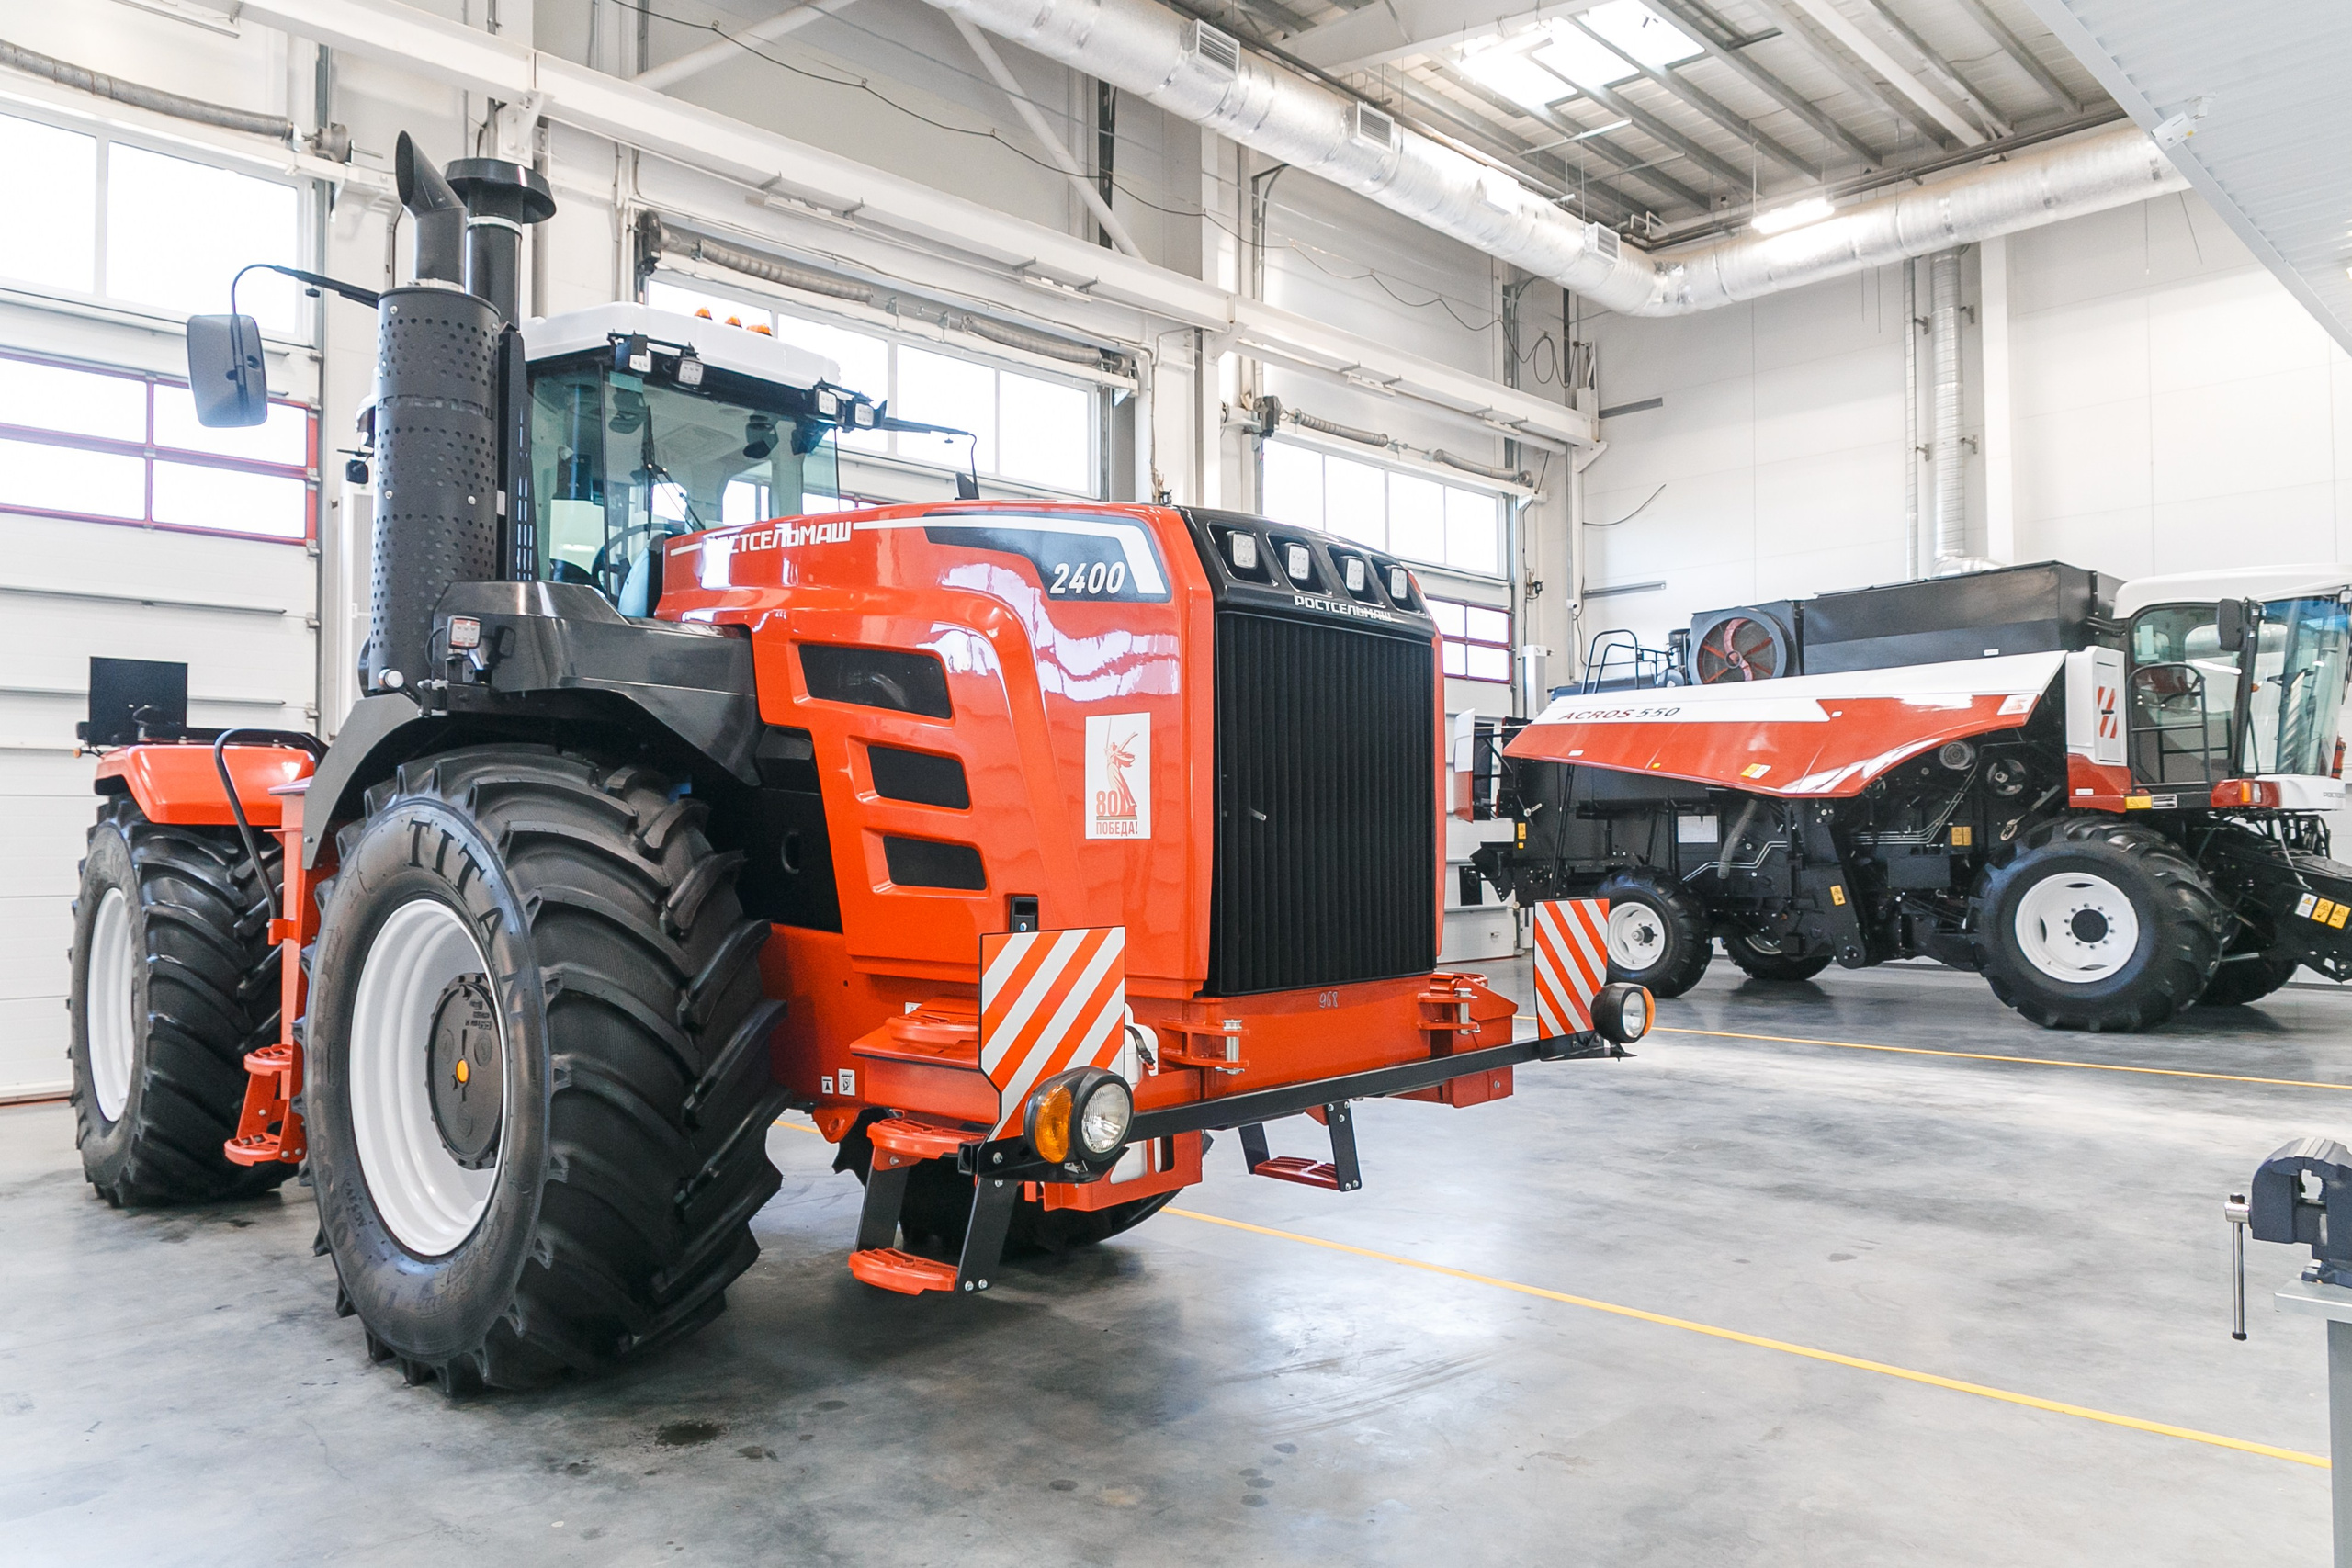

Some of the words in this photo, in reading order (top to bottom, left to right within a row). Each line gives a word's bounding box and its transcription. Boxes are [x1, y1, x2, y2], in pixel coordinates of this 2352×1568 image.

[1049, 561, 1125, 594] 2400
[1294, 595, 1392, 622] РОСТСЕЛЬМАШ
[1558, 709, 1634, 720] ACROS
[1635, 707, 1681, 718] 550
[1096, 790, 1119, 817] 80
[1096, 821, 1138, 836] ПОБЕДА!
[1319, 991, 1338, 1009] 968
